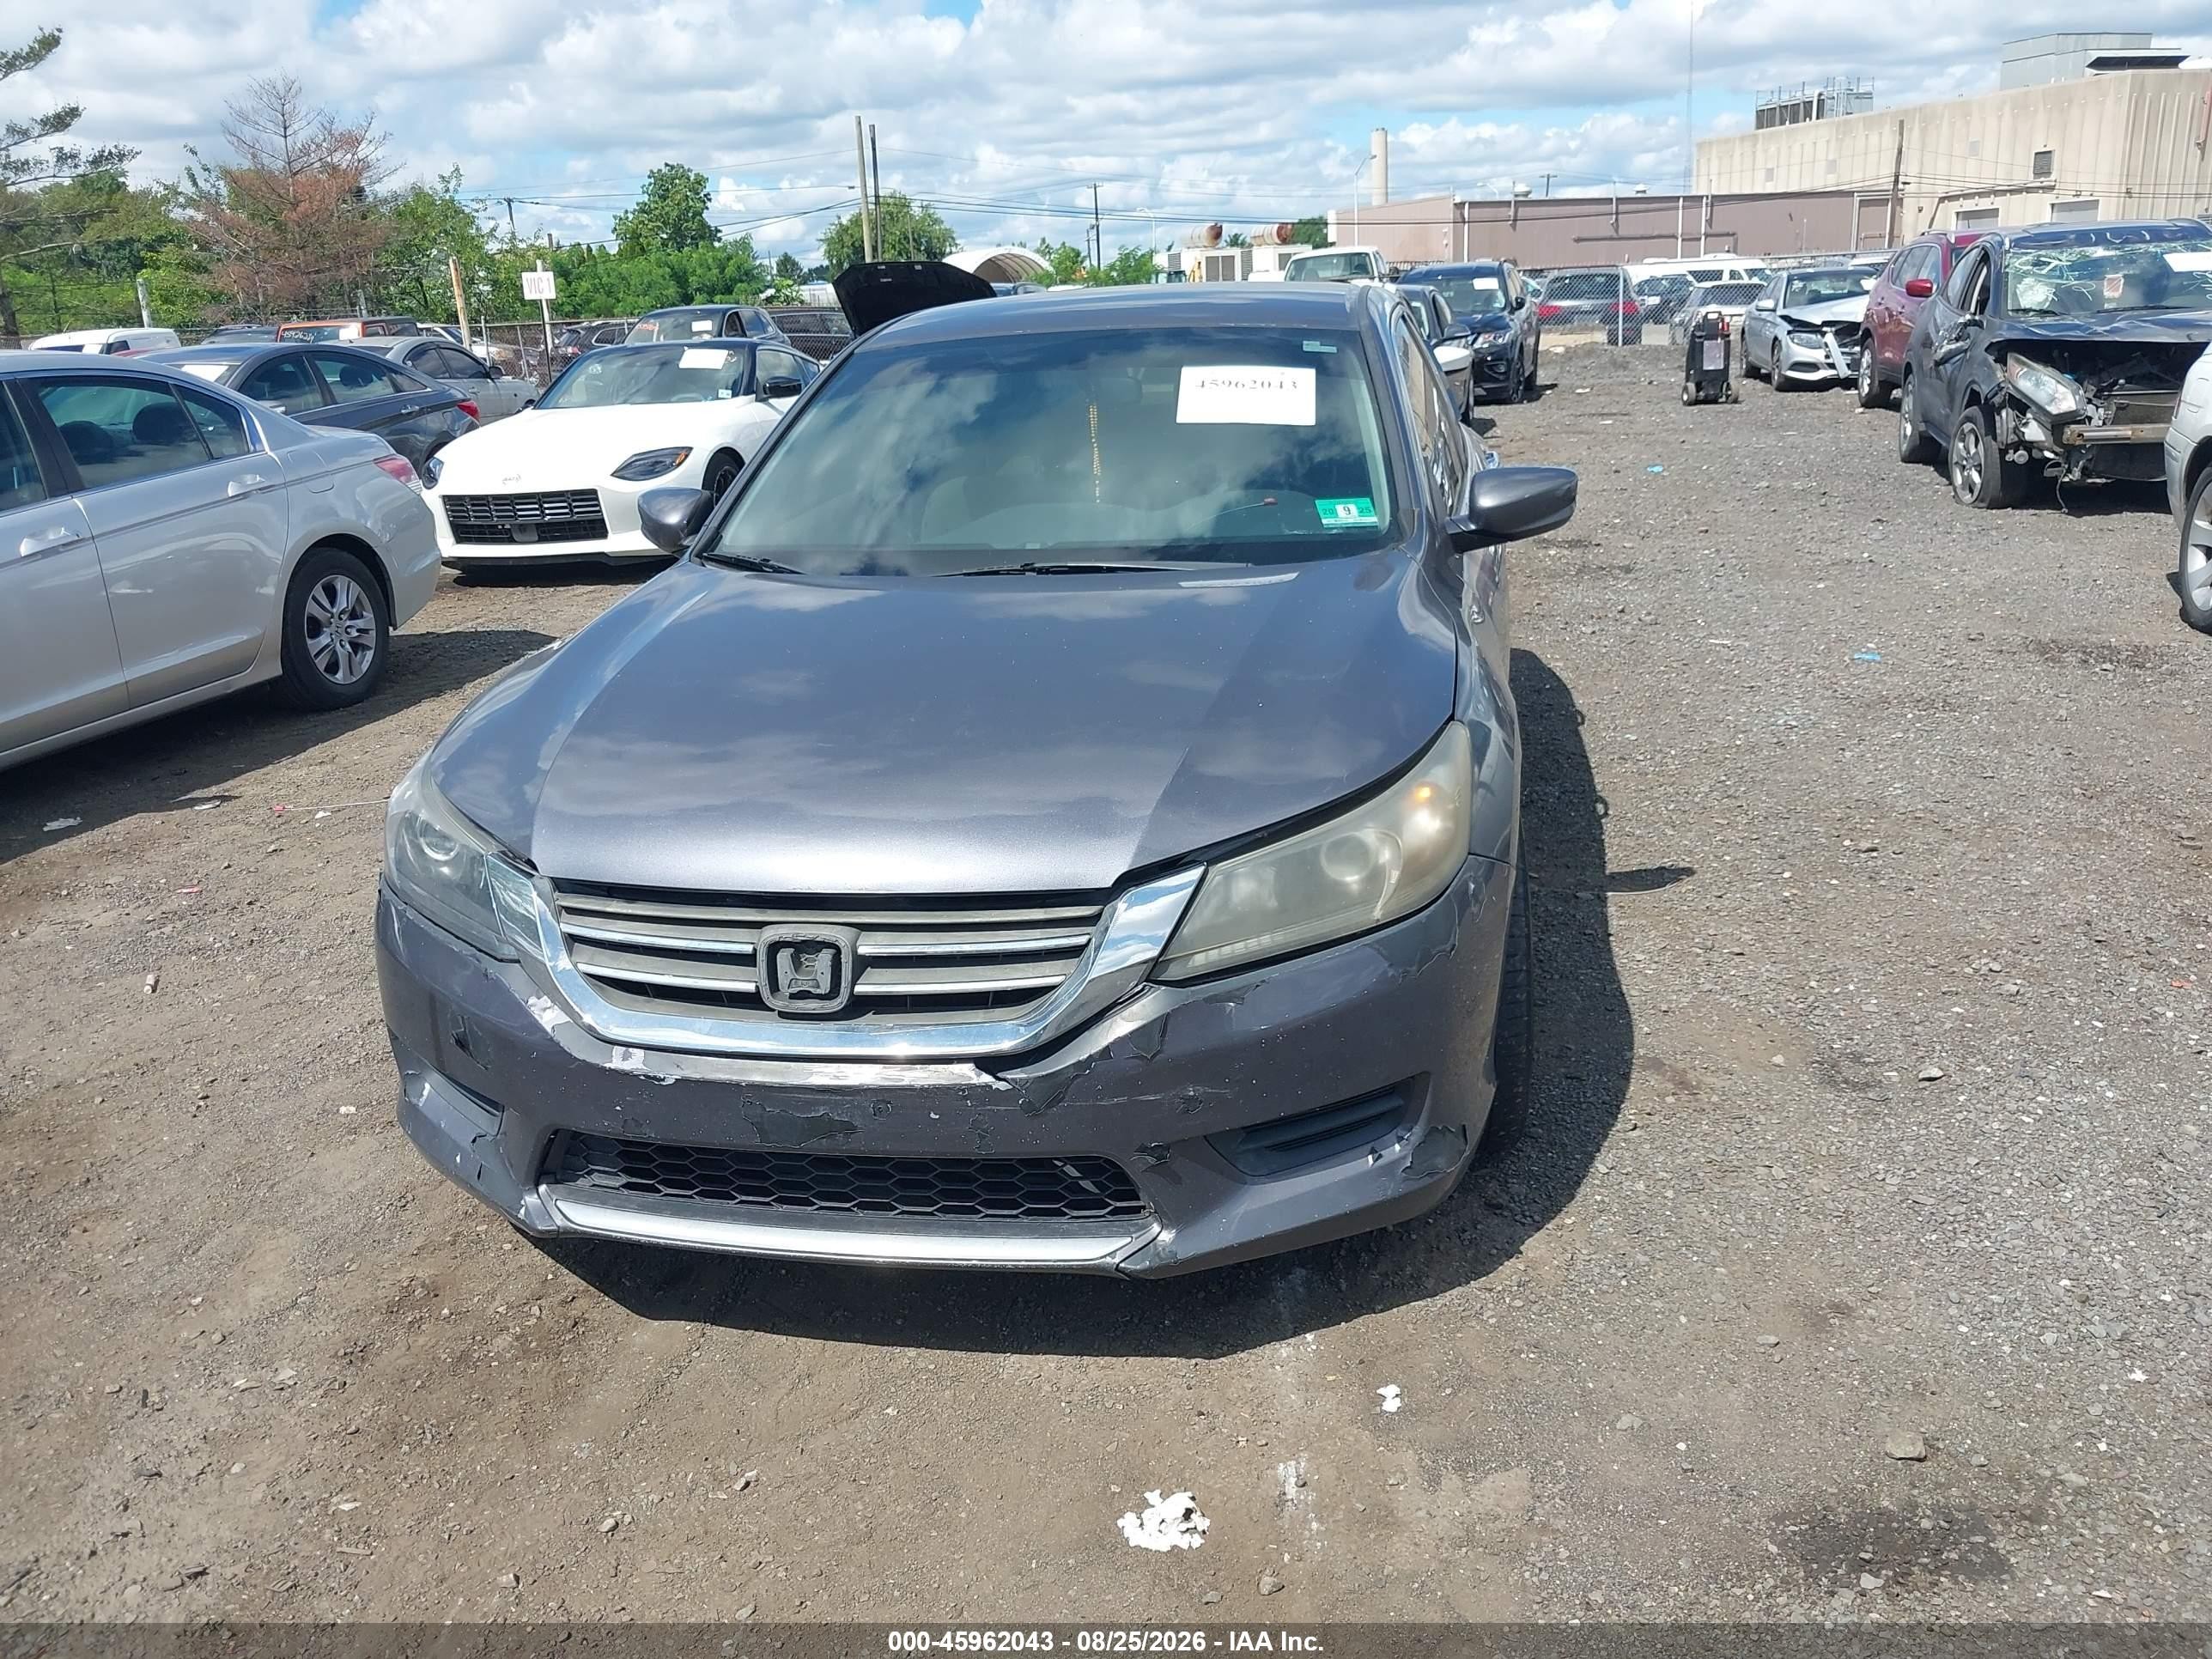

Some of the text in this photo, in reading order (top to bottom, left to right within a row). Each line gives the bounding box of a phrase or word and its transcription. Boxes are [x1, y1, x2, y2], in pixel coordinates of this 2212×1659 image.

[526, 276, 544, 295] VIC
[1195, 379, 1298, 390] 45962043
[1342, 506, 1352, 515] 9
